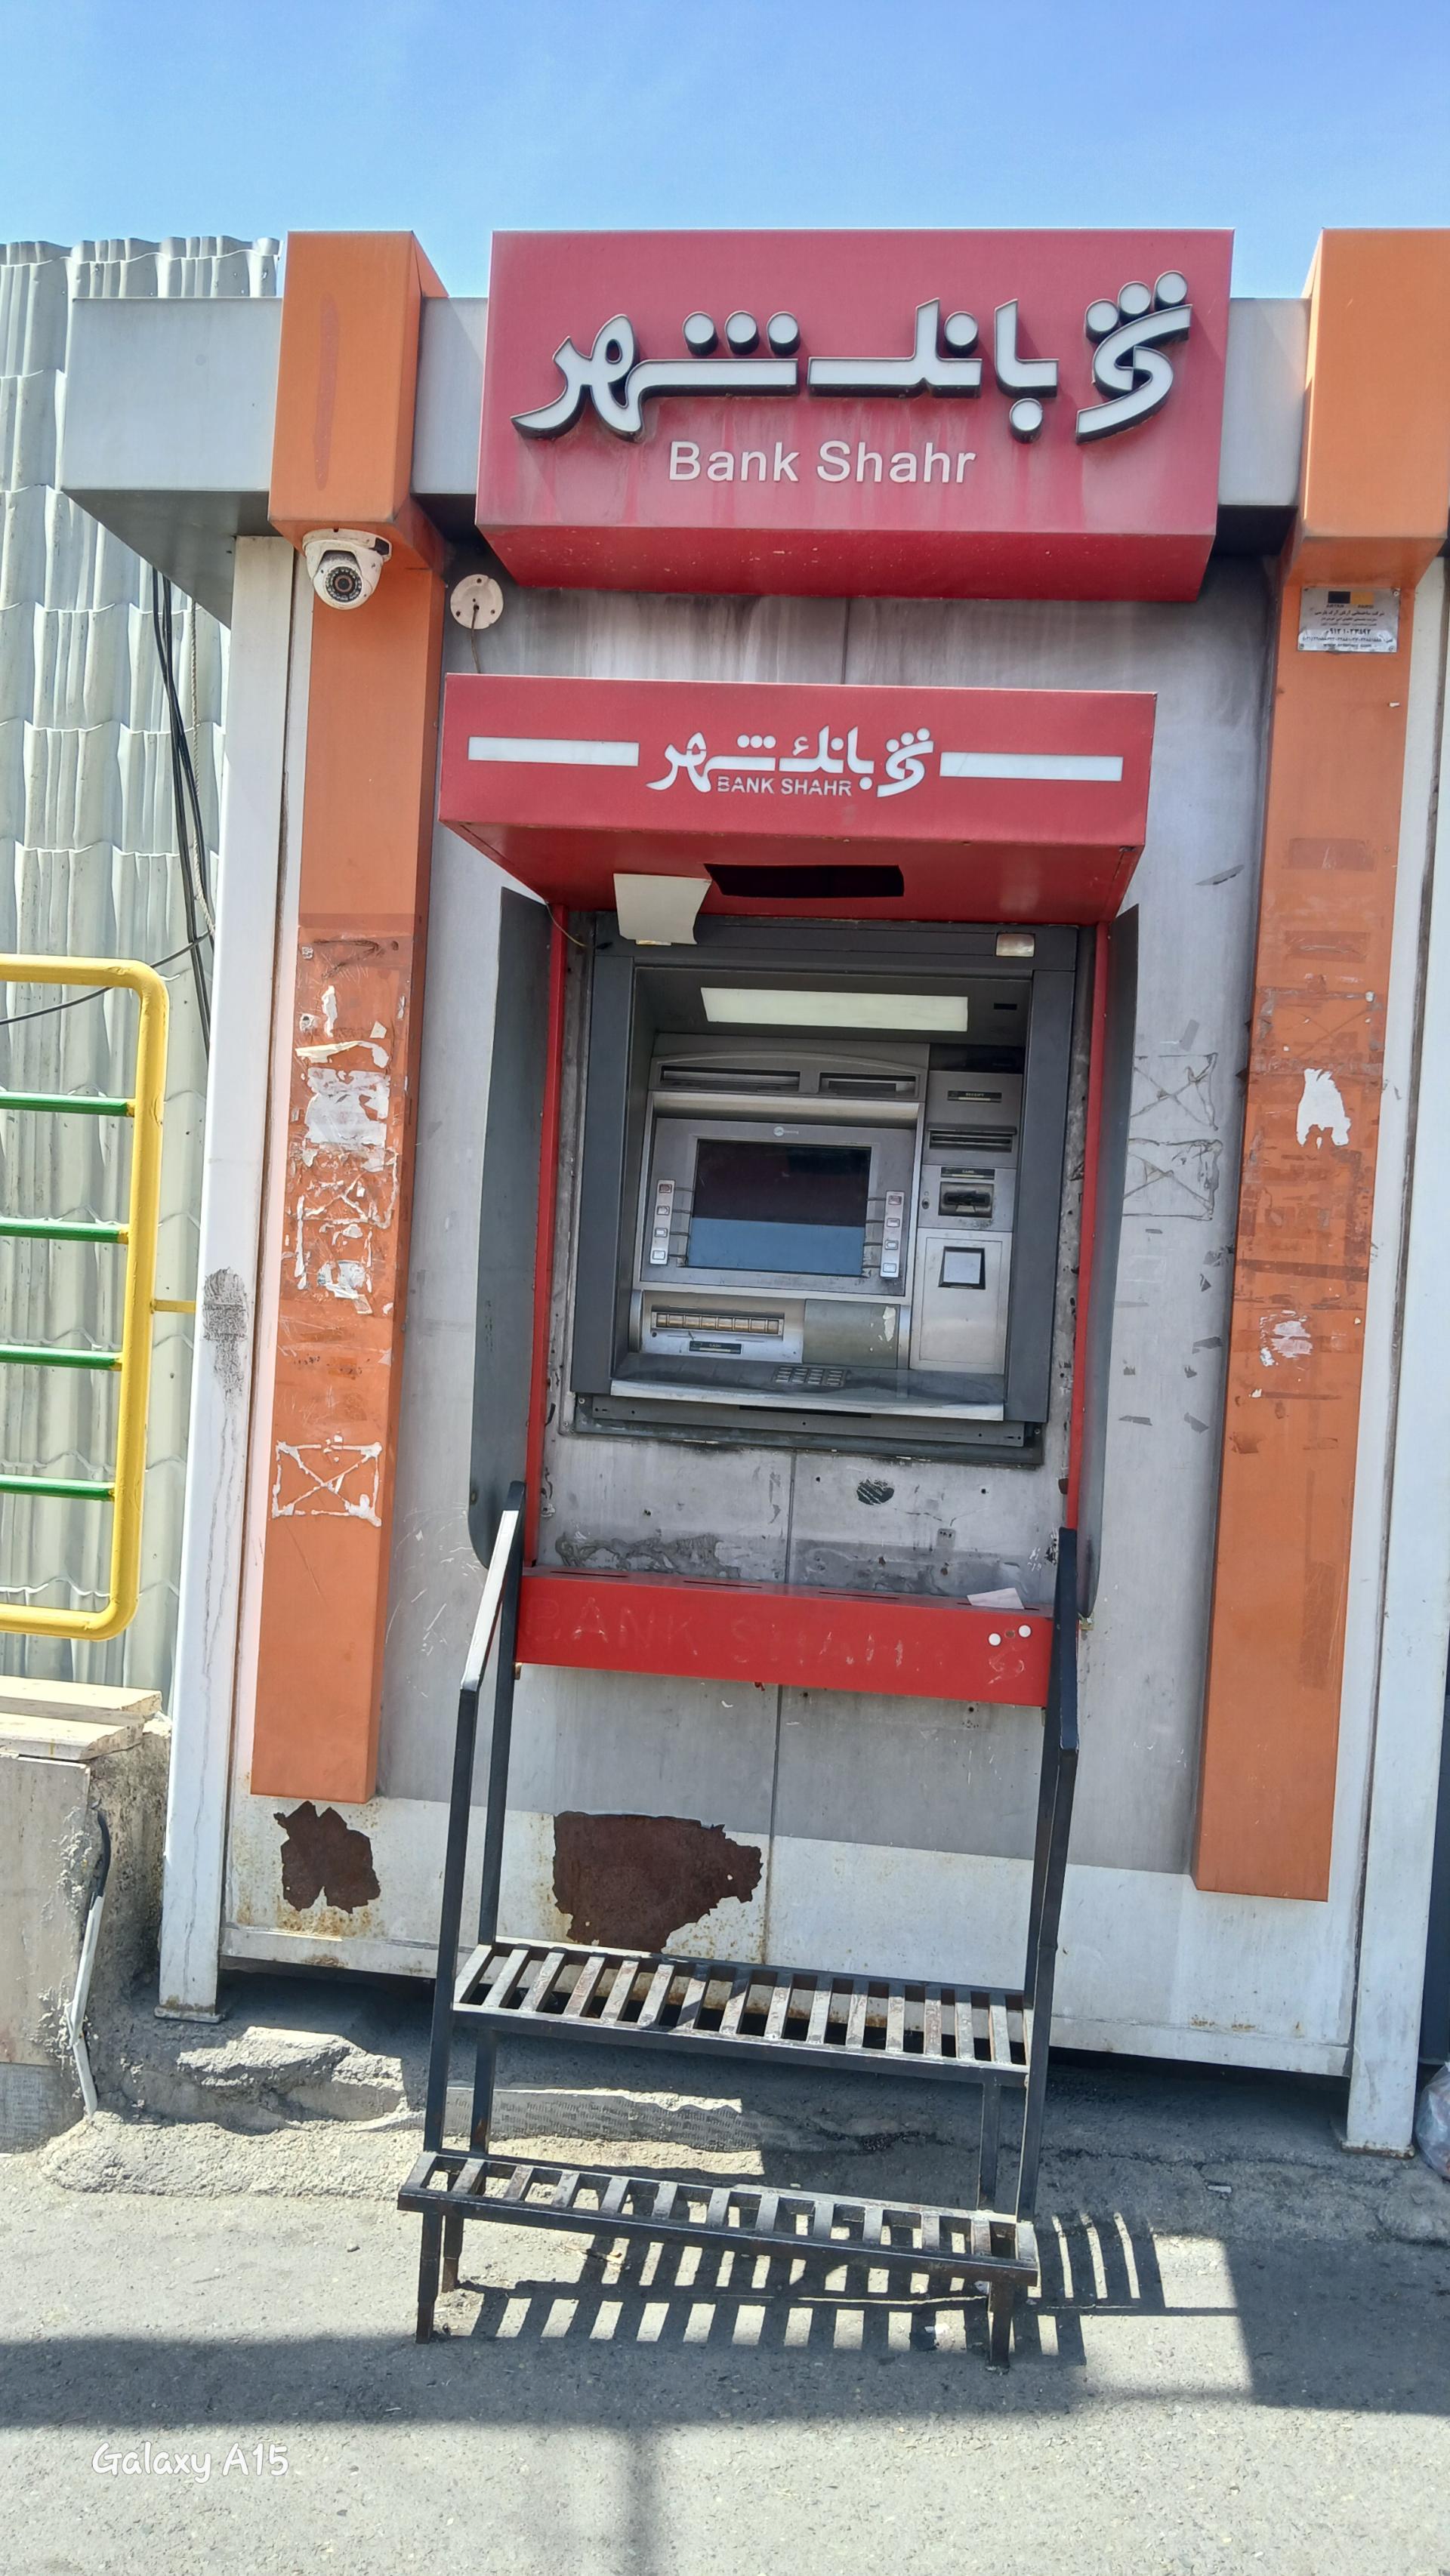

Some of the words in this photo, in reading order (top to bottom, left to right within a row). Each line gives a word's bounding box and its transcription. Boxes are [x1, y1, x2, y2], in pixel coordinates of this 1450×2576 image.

[510, 310, 800, 442] شهر
[668, 441, 799, 483] Bank
[816, 441, 976, 485] Shahr
[645, 732, 776, 793] شهر
[717, 776, 775, 795] BANK
[780, 778, 853, 797] SHAHR
[779, 725, 875, 791] بانک
